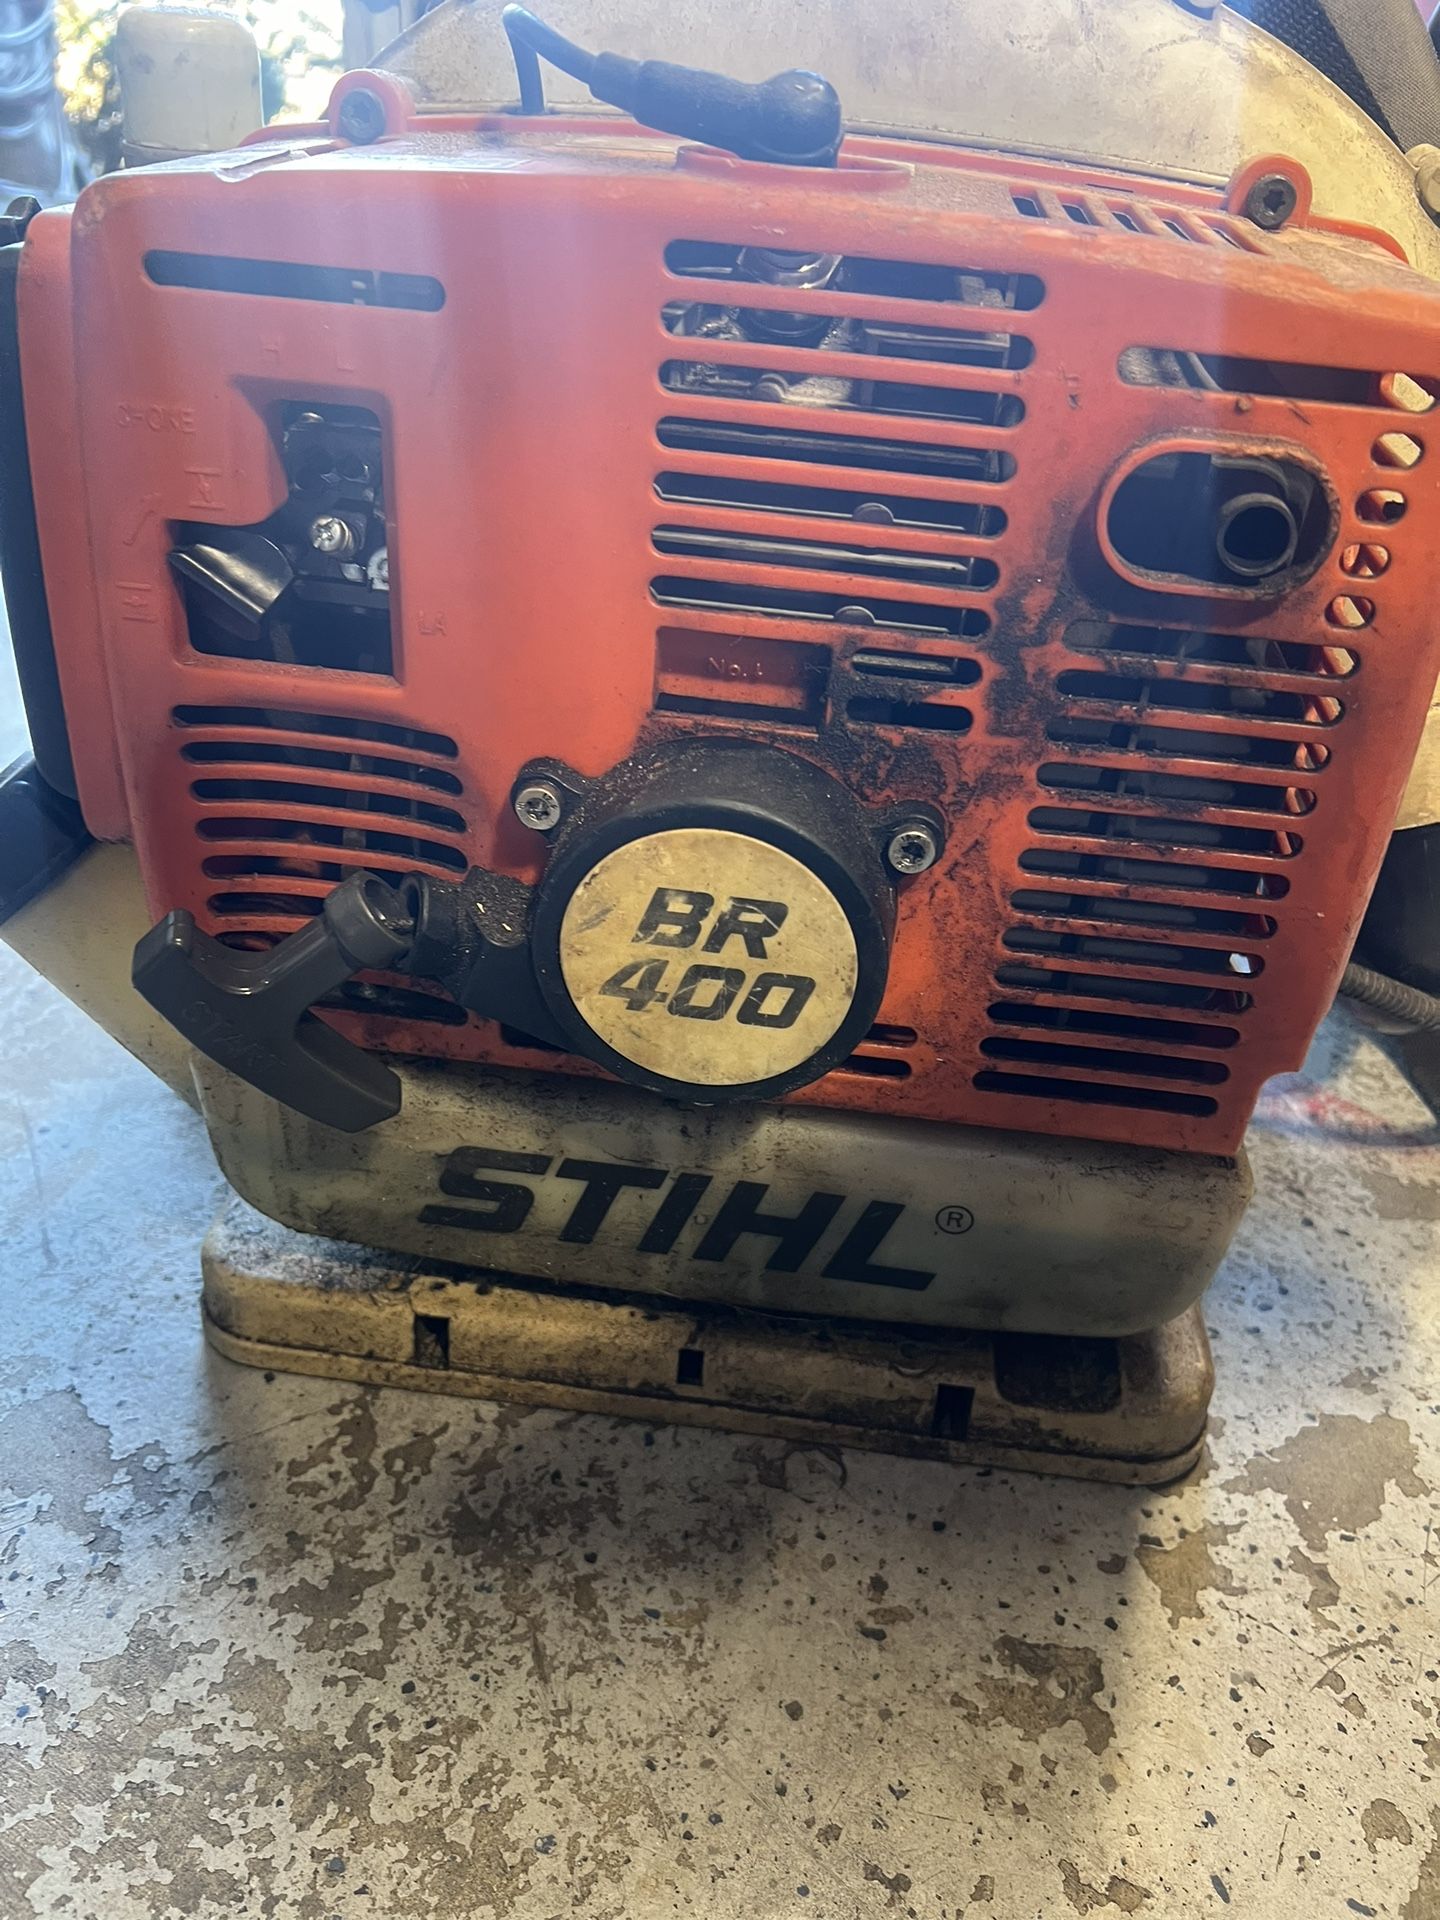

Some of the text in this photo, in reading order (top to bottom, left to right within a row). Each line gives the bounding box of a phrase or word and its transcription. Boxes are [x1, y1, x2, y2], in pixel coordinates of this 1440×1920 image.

[631, 886, 789, 960] BR
[599, 958, 816, 1030] 400
[418, 1145, 938, 1292] STIHL
